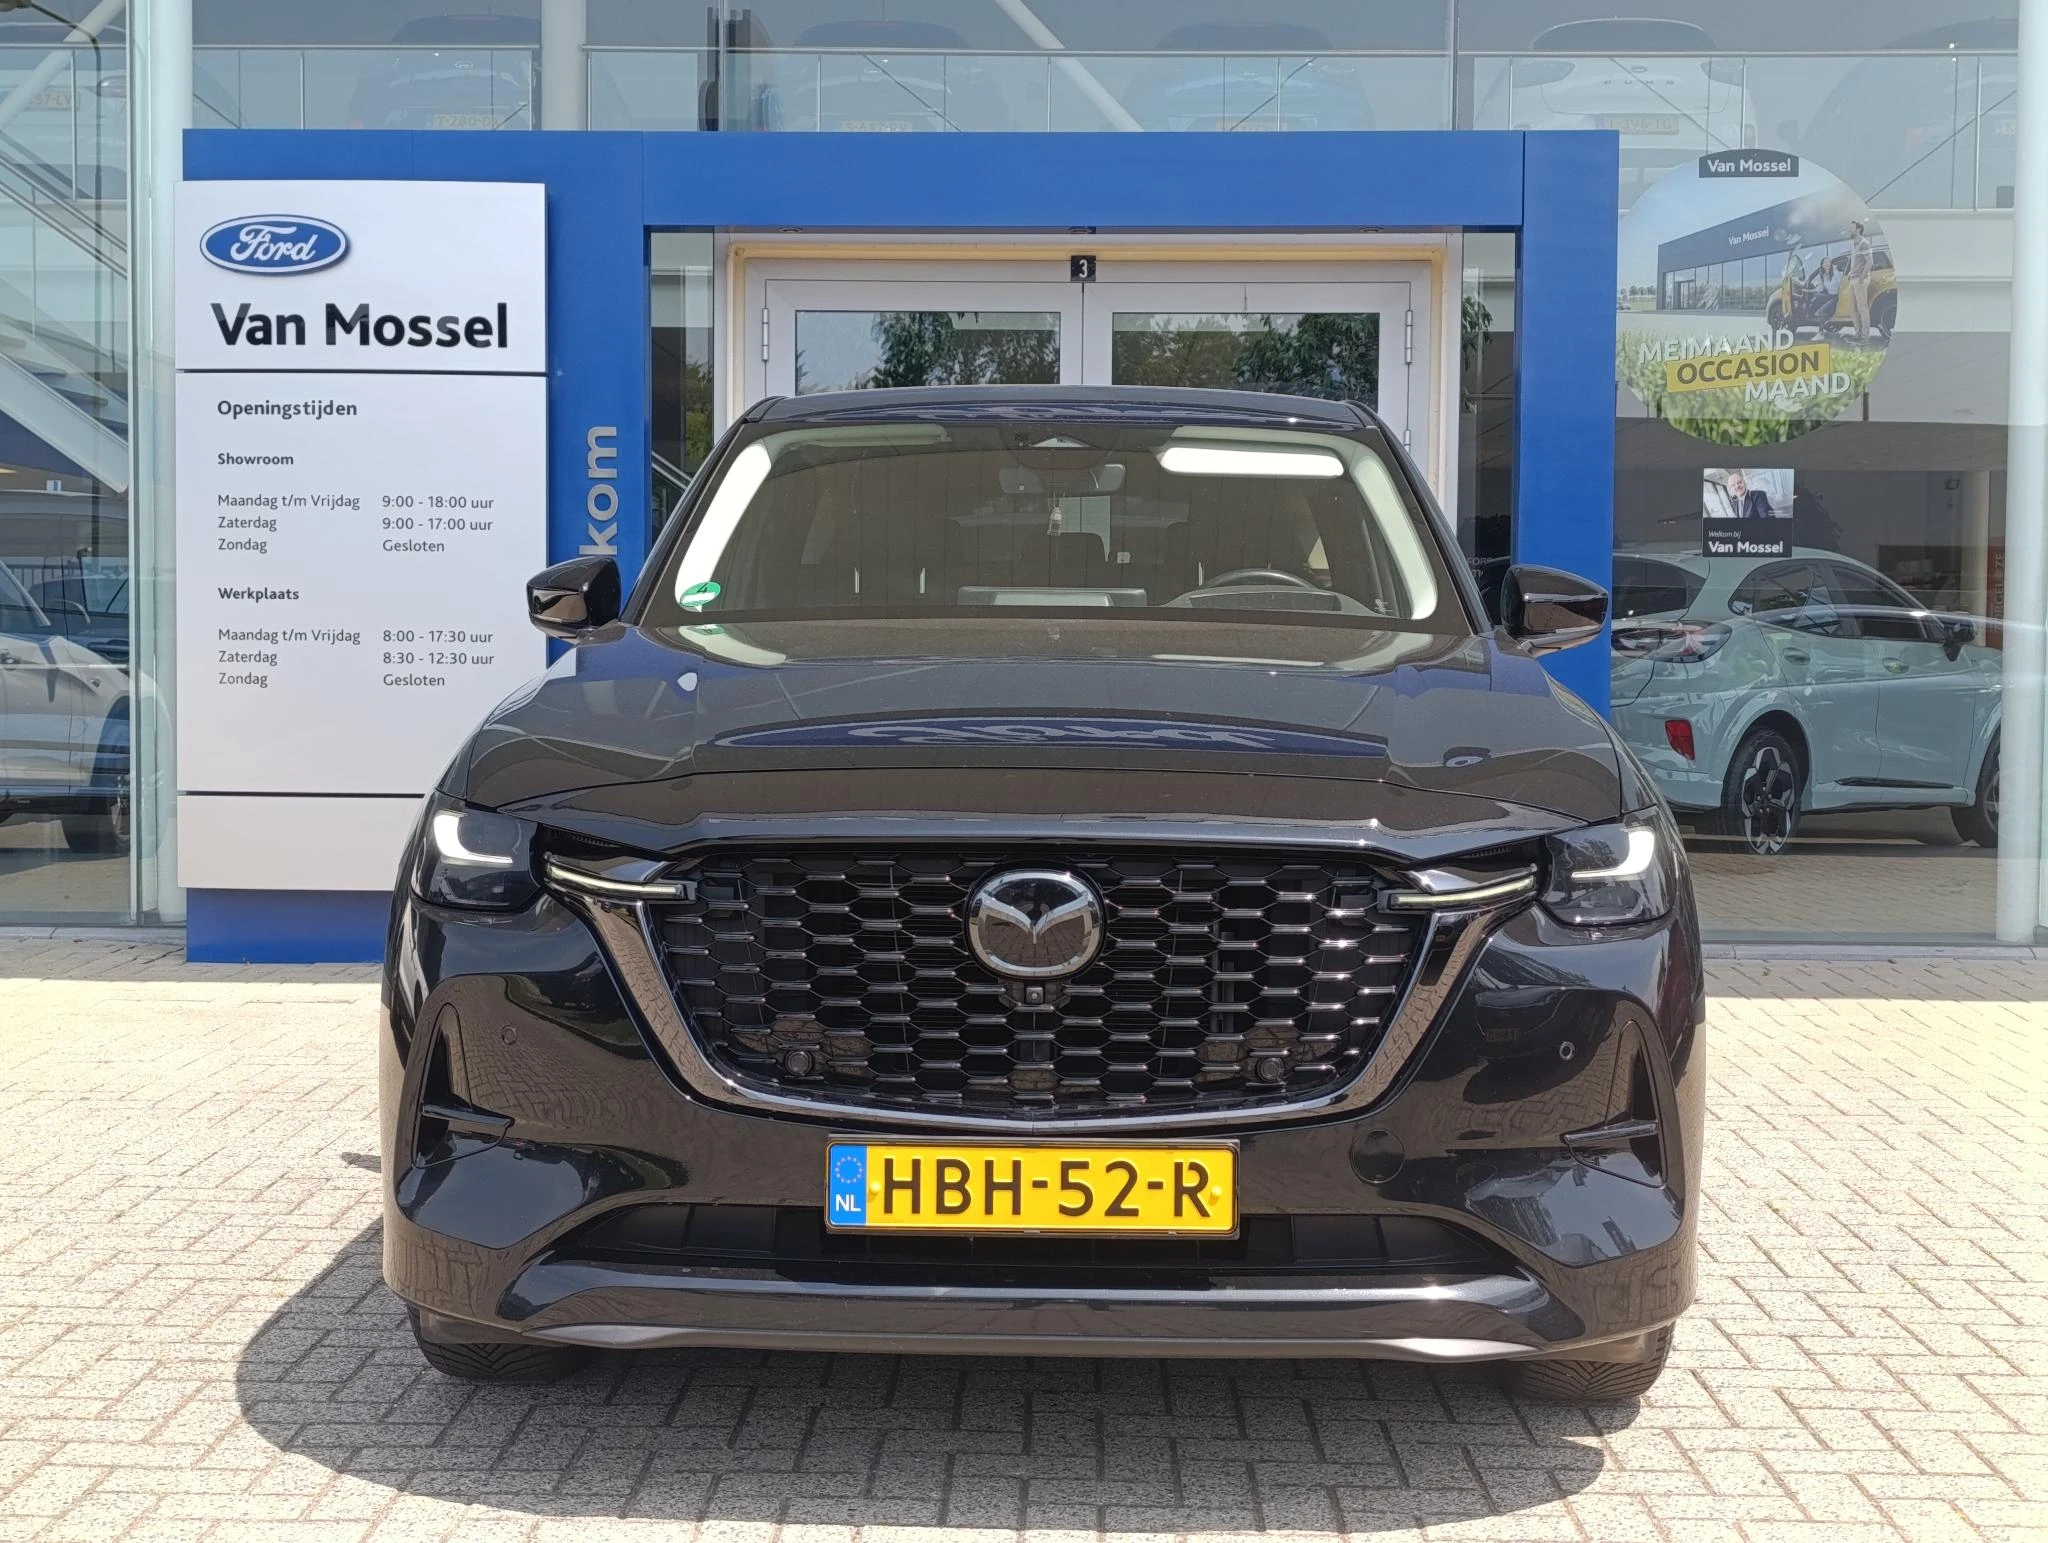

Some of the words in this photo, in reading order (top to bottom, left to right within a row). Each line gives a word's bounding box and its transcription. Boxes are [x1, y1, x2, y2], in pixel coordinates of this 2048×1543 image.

[1707, 159, 1735, 172] Van
[1740, 158, 1791, 172] Mossel
[230, 224, 319, 261] Ford
[1728, 235, 1742, 246] Van
[1742, 226, 1770, 244] Mossel
[1079, 259, 1088, 278] 3
[211, 303, 305, 346] Van
[326, 303, 507, 348] Mossel
[1639, 330, 1795, 364] MEIMAAND
[1677, 351, 1820, 384] OCCASION
[1745, 372, 1851, 402] MAAND
[217, 400, 357, 420] Openingstijden
[217, 452, 294, 466] Showroom
[217, 493, 278, 510] Maandag
[282, 494, 307, 508] t/m
[311, 493, 361, 511] Vrijdag
[382, 496, 413, 509] 9:00
[427, 496, 467, 509] 18:00
[471, 499, 495, 509] uur
[217, 516, 278, 532] Zaterdag
[382, 518, 413, 530] 9:00
[427, 518, 466, 531] 17:00
[470, 521, 494, 531] uur
[1708, 530, 1733, 538] Welkom
[217, 537, 268, 554] Zondag
[382, 539, 446, 553] Gesloten
[1708, 541, 1734, 553] Van
[1737, 541, 1784, 553] Mossel
[217, 586, 300, 604] Werkplaats
[218, 628, 279, 645] Maandag
[282, 628, 308, 642] t/m
[311, 628, 361, 645] Vrijdag
[382, 630, 415, 642] 8:00
[428, 630, 466, 643] 17:30
[470, 634, 494, 643] uur
[218, 650, 278, 667] Zaterdag
[382, 652, 415, 664] 8:30
[428, 652, 468, 665] 12:30
[471, 655, 495, 665] uur
[218, 671, 268, 688] Zondag
[382, 673, 446, 687] Gesloten
[884, 1157, 1211, 1218] HBH-52-R
[835, 1194, 861, 1212] NL
